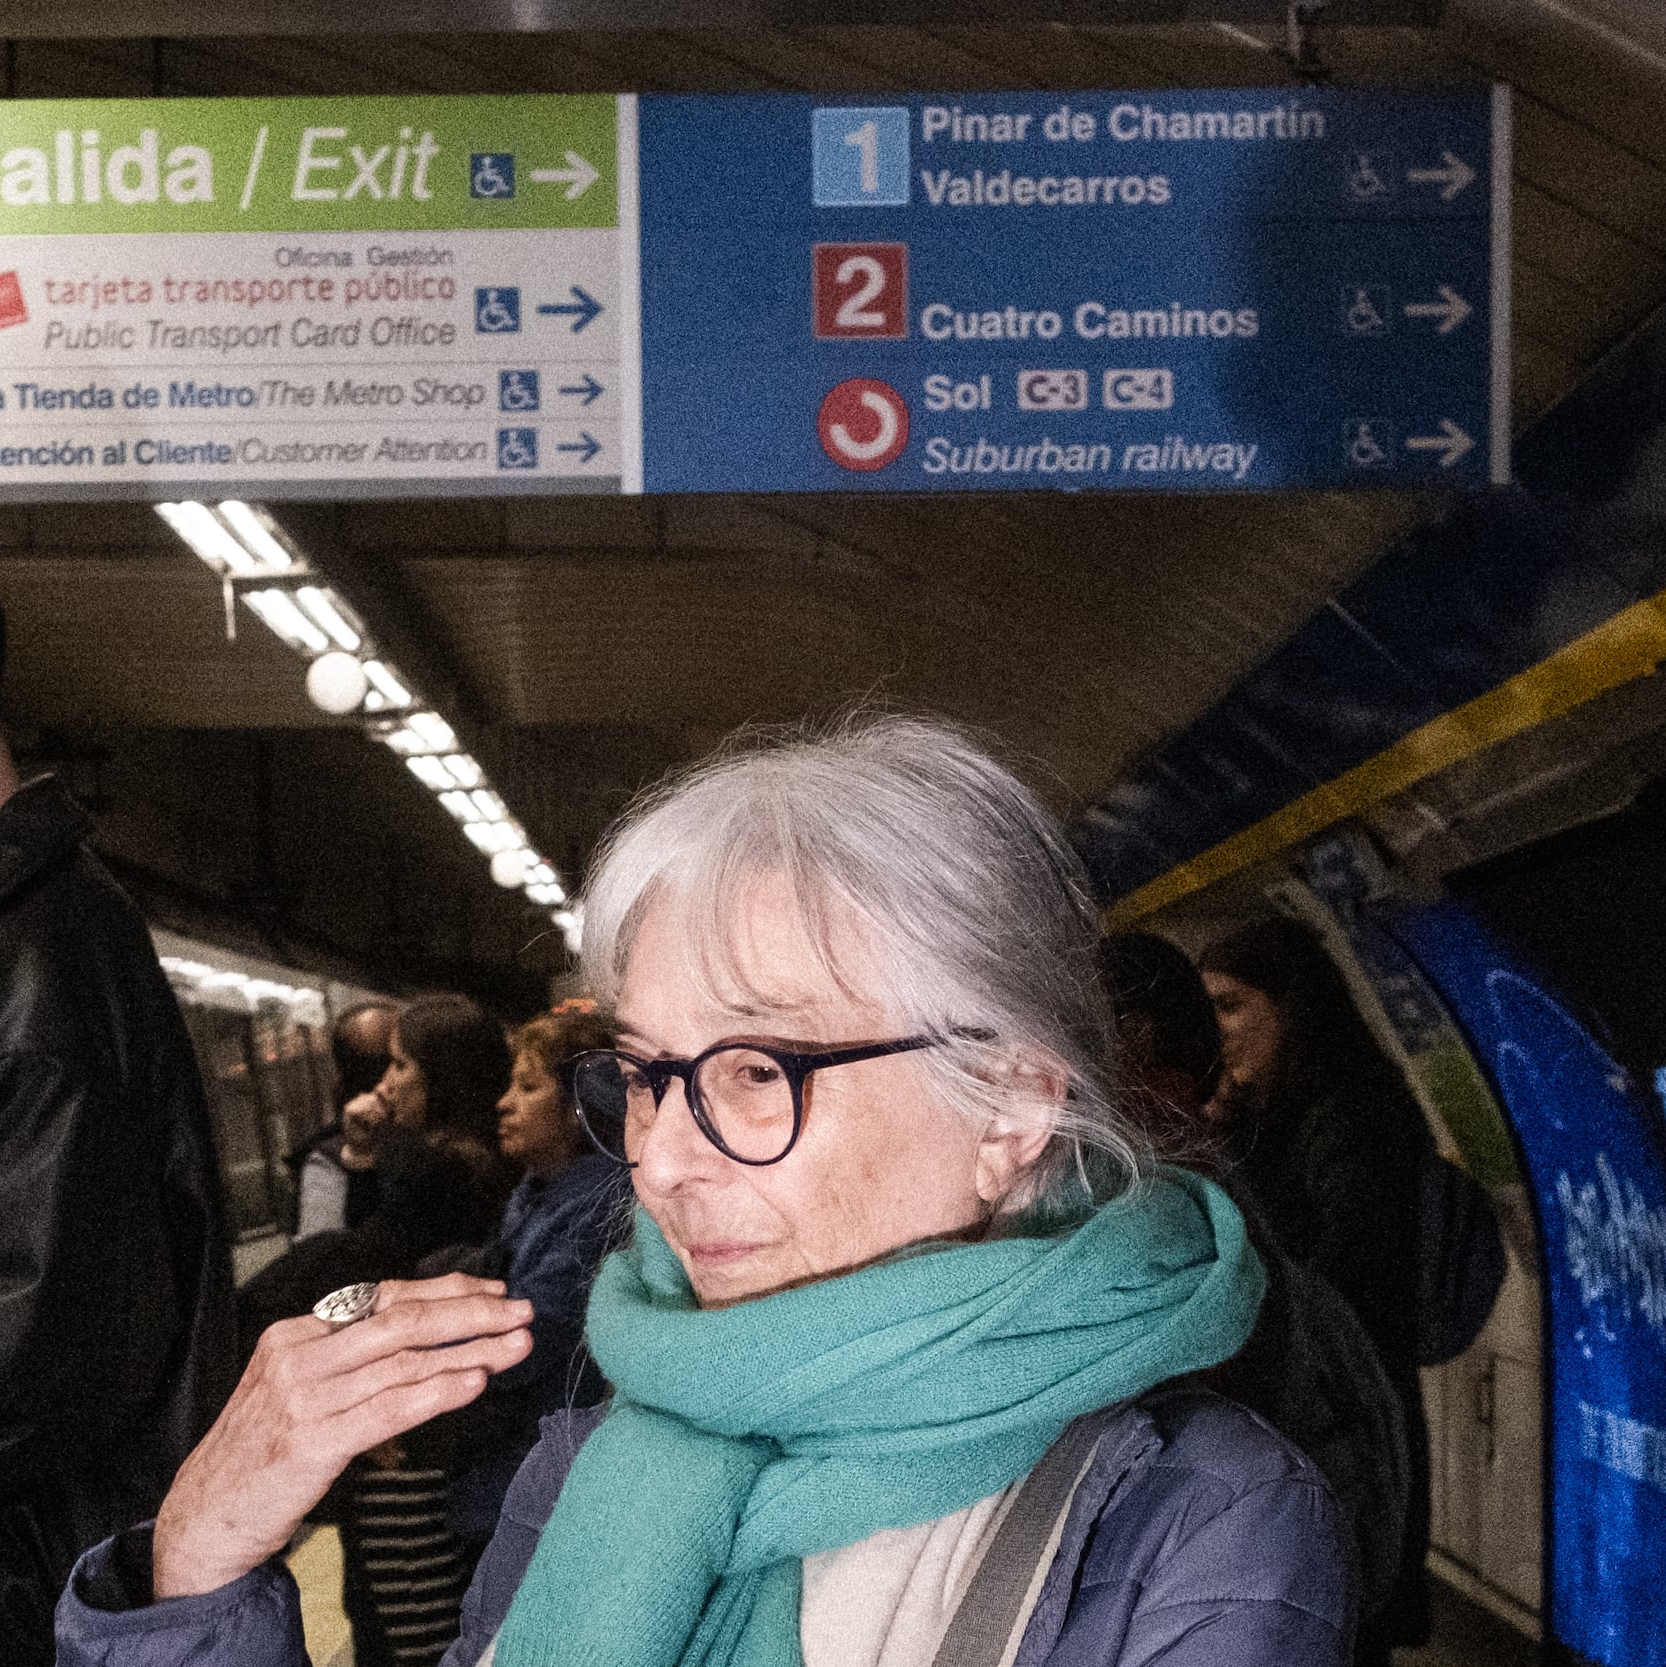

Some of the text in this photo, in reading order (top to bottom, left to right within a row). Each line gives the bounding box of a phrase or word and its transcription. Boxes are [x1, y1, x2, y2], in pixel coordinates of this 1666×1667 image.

[921, 101, 1327, 144] Pinar de Chamartín
[290, 126, 441, 201] Exit
[844, 119, 879, 194] 1
[920, 169, 1172, 206] Valdecarros
[274, 245, 455, 268] Oficina Gestión
[44, 270, 456, 309] tarjeta transporte público
[835, 255, 887, 328] 2
[44, 316, 457, 353] Public Transport Card Office
[920, 301, 1261, 341] Cuatro Caminos
[13, 382, 115, 411] Tienda
[123, 382, 159, 409] de
[322, 380, 404, 408] Metro
[412, 378, 488, 411] Shop
[923, 373, 1166, 411] Sol C-3 C-4
[102, 439, 127, 468] al
[373, 436, 489, 464] Attention
[922, 434, 1259, 480] Suburban railway
